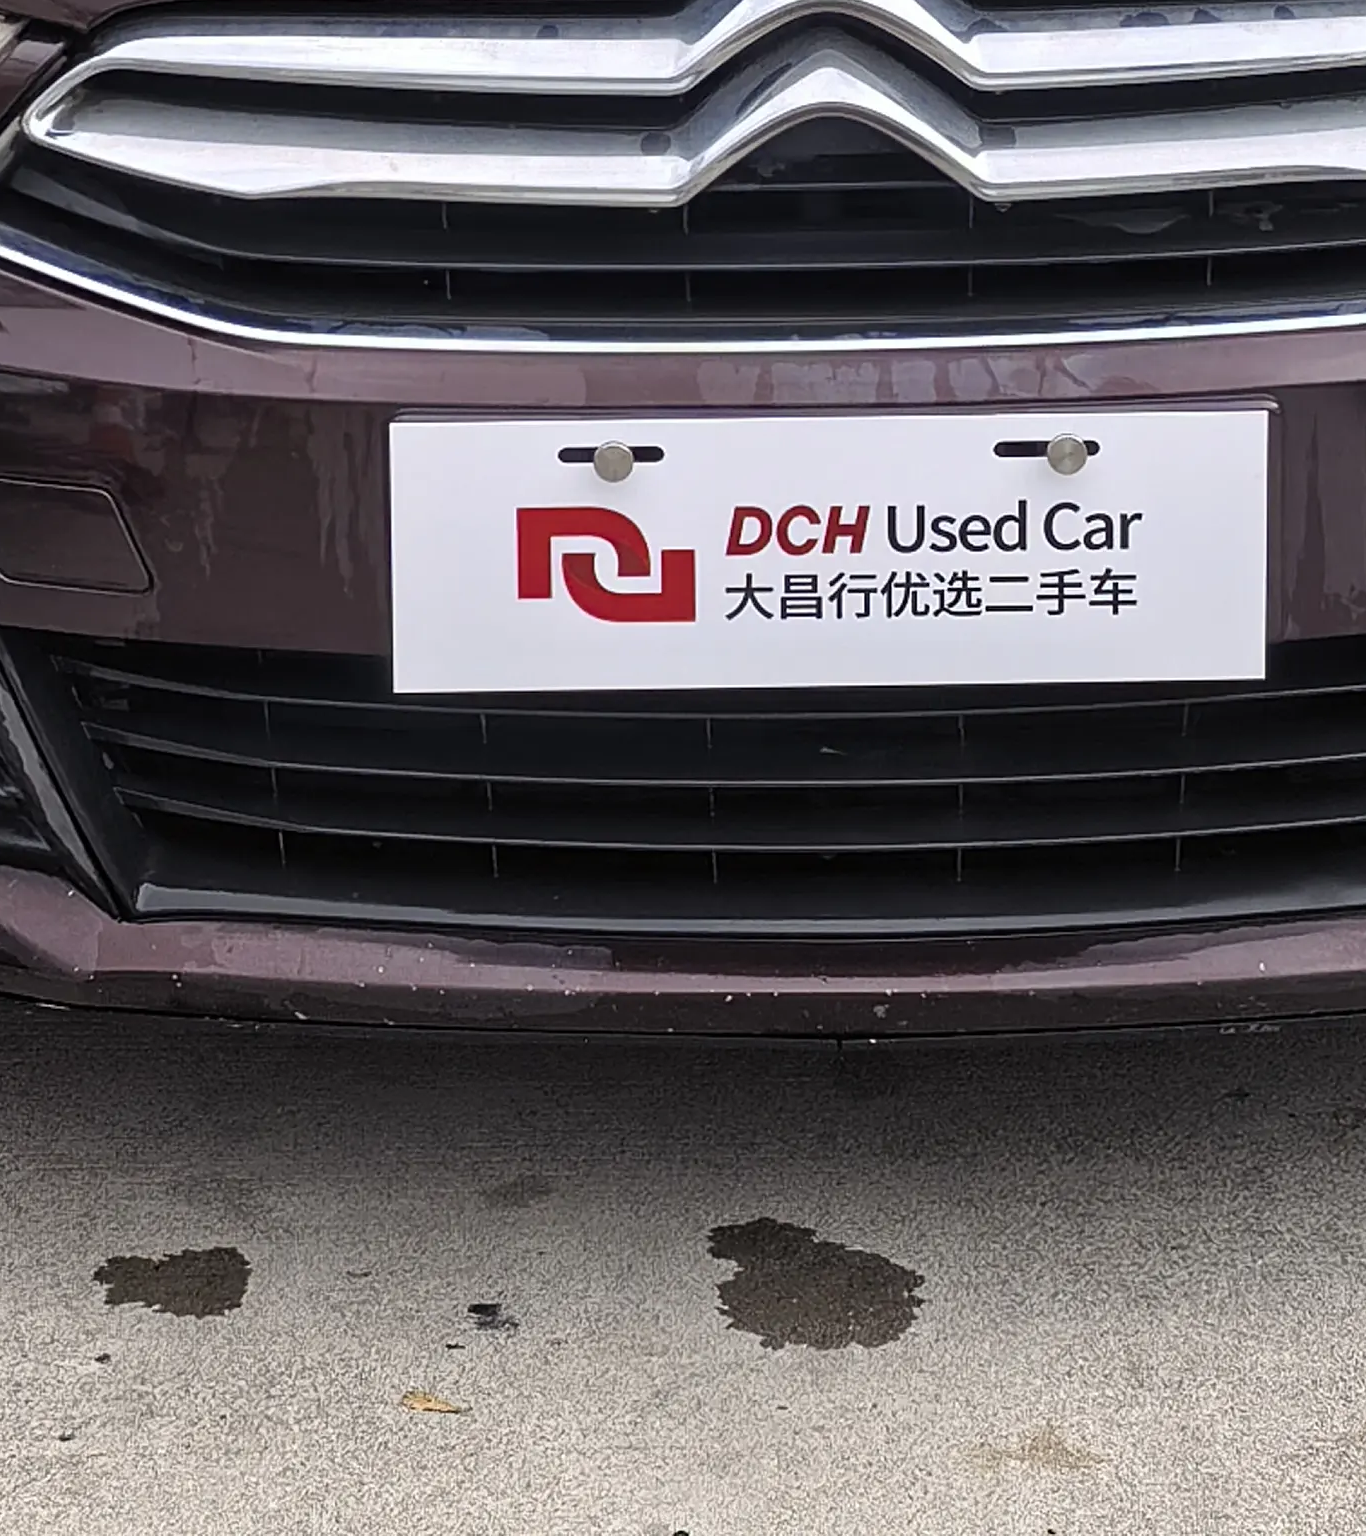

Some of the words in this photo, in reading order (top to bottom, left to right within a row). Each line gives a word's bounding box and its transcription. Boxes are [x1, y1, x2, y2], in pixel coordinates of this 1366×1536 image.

[726, 504, 871, 557] DCH
[887, 500, 1027, 553] Used
[1043, 502, 1143, 552] Car
[725, 568, 1138, 621] 大昌行优选二手车
